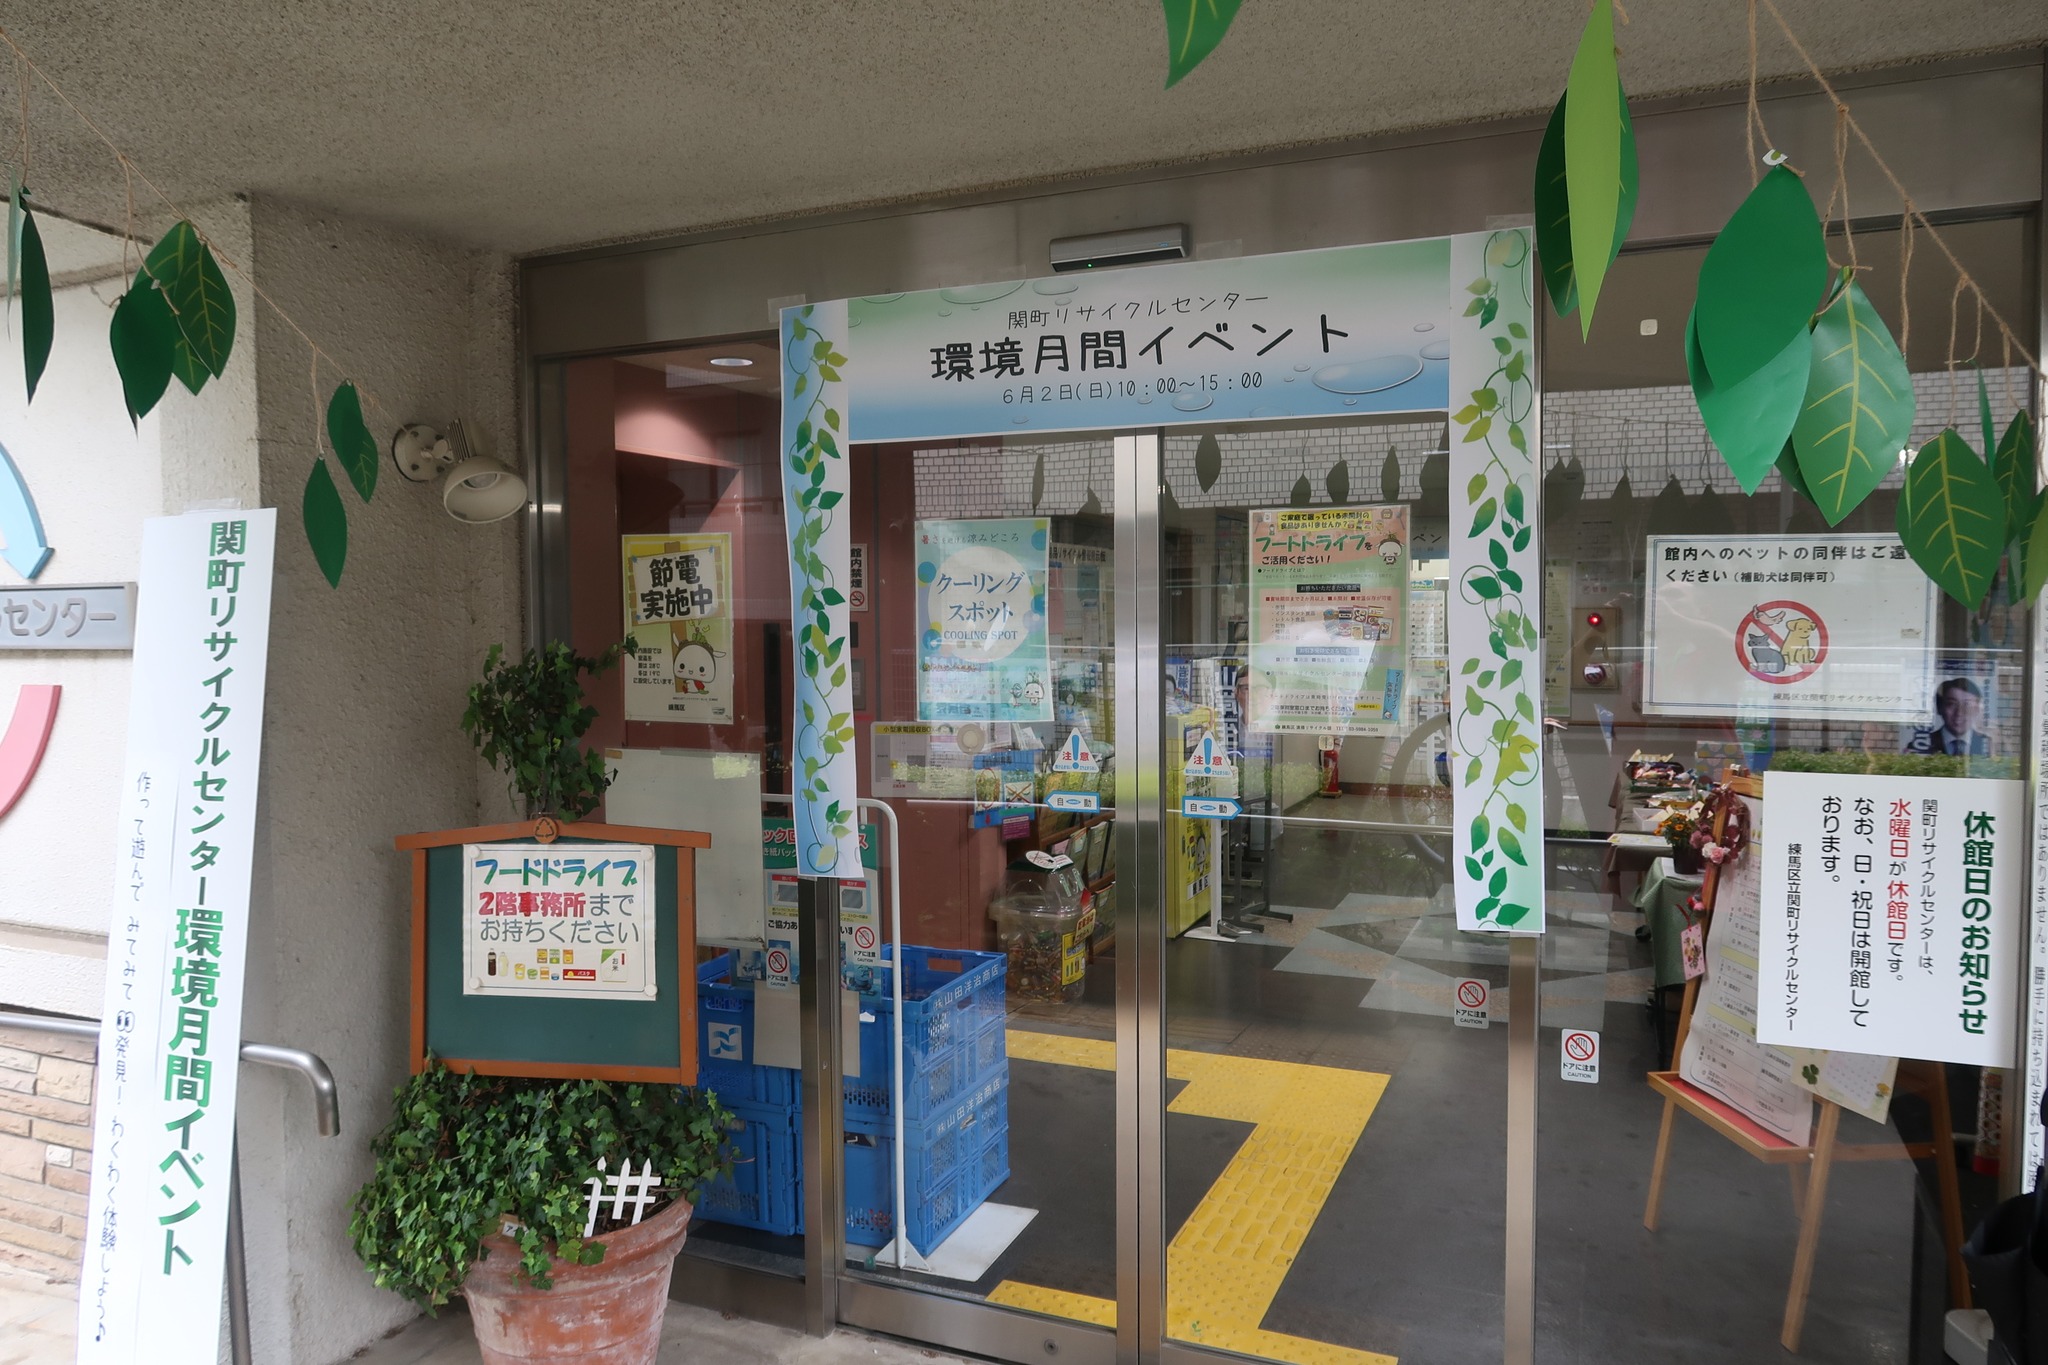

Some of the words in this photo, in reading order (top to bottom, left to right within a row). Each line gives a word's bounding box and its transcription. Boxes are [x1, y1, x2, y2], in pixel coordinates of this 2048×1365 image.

[1007, 292, 1269, 330] 関町リサイクルセンター
[930, 314, 1349, 382] 環境月間イベント
[850, 547, 862, 588] 館内禁煙
[1261, 555, 1331, 566] ご活用ください！
[1665, 545, 1912, 561] 館内へのペットの同伴はご遠
[649, 554, 701, 588] 節電
[936, 571, 1026, 594] クーリング
[641, 584, 713, 619] 実施中
[948, 601, 1014, 622] スポット
[0, 598, 116, 637] センター
[944, 631, 987, 640] COOLING
[991, 630, 1018, 640] SPOT
[1773, 692, 1912, 703] 練馬区立関町リサイクルセンター
[1821, 795, 1843, 883] おります。
[475, 858, 638, 887] フードドライブ
[1918, 799, 1938, 976] 関町リサイクルセンターは、
[478, 892, 634, 918] 2階事務所まで
[1886, 798, 1912, 982] 水曜日が休館日です。
[768, 919, 798, 930] ご協力あ
[1849, 797, 1875, 1028] なお、日・祝日は開館して
[1958, 810, 1996, 1035] 休館日のお知らせ
[480, 919, 639, 944] お持ちください
[1785, 843, 1802, 1031] 練馬区立関町リサイクルセンター
[1455, 1008, 1487, 1019] ドアに注意
[1563, 1063, 1596, 1073] ドアに注意
